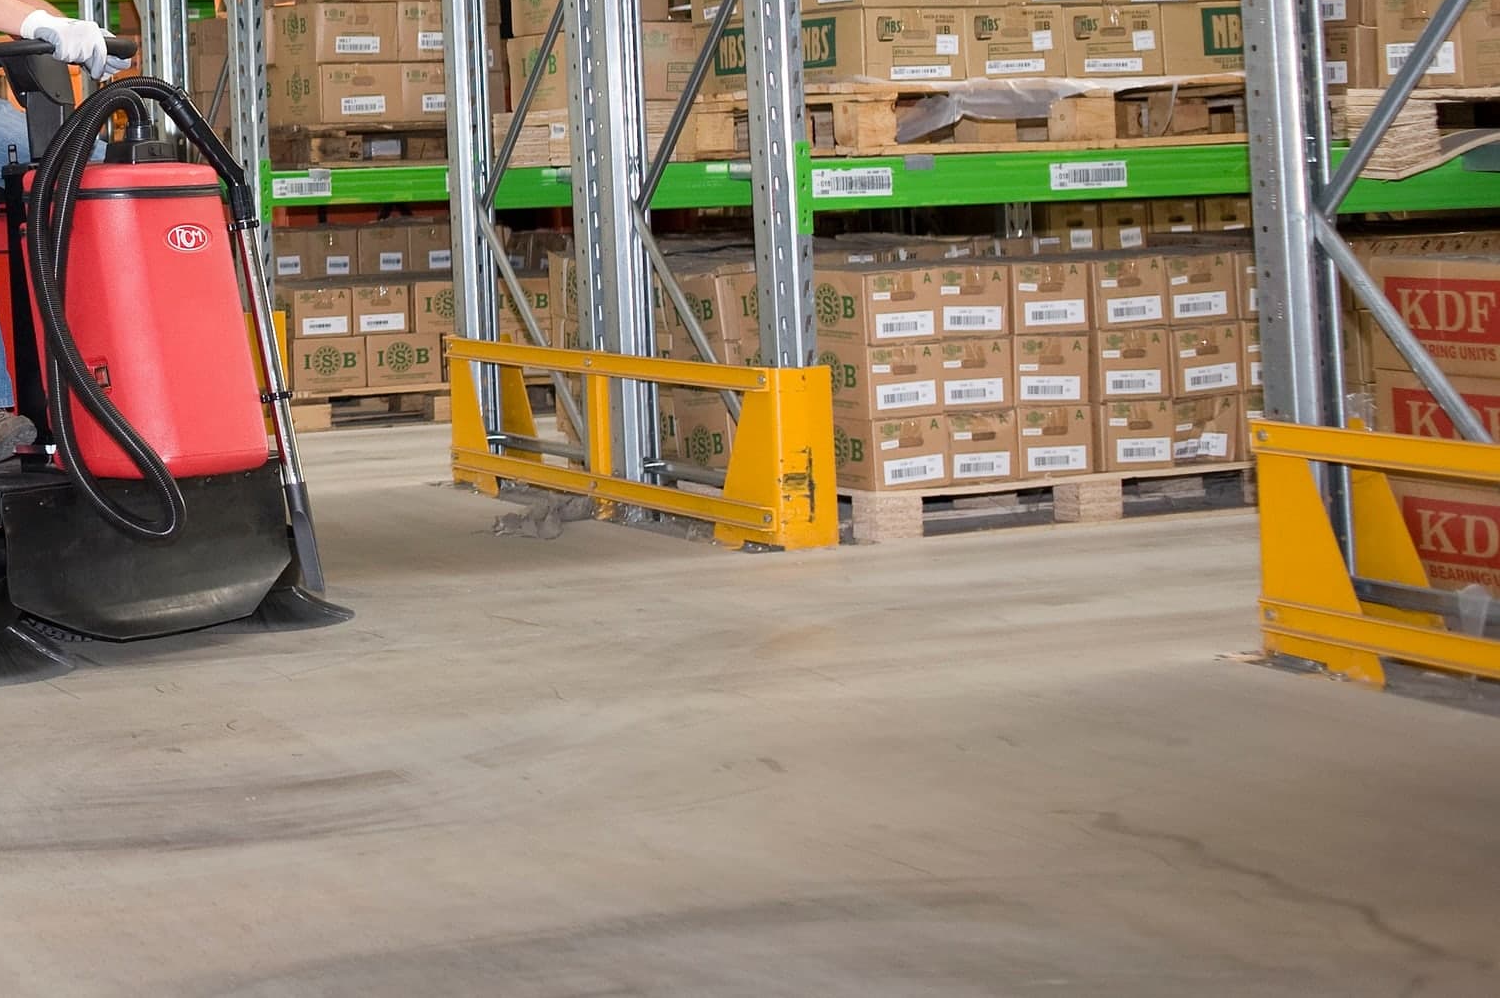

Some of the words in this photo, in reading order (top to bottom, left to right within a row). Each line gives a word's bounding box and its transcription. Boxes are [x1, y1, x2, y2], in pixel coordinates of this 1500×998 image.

[1212, 14, 1242, 50] NB
[817, 290, 855, 321] SB
[1397, 287, 1497, 335] KDF
[304, 349, 358, 372] ISB
[378, 344, 431, 368] ISB
[1416, 509, 1500, 559] KD
